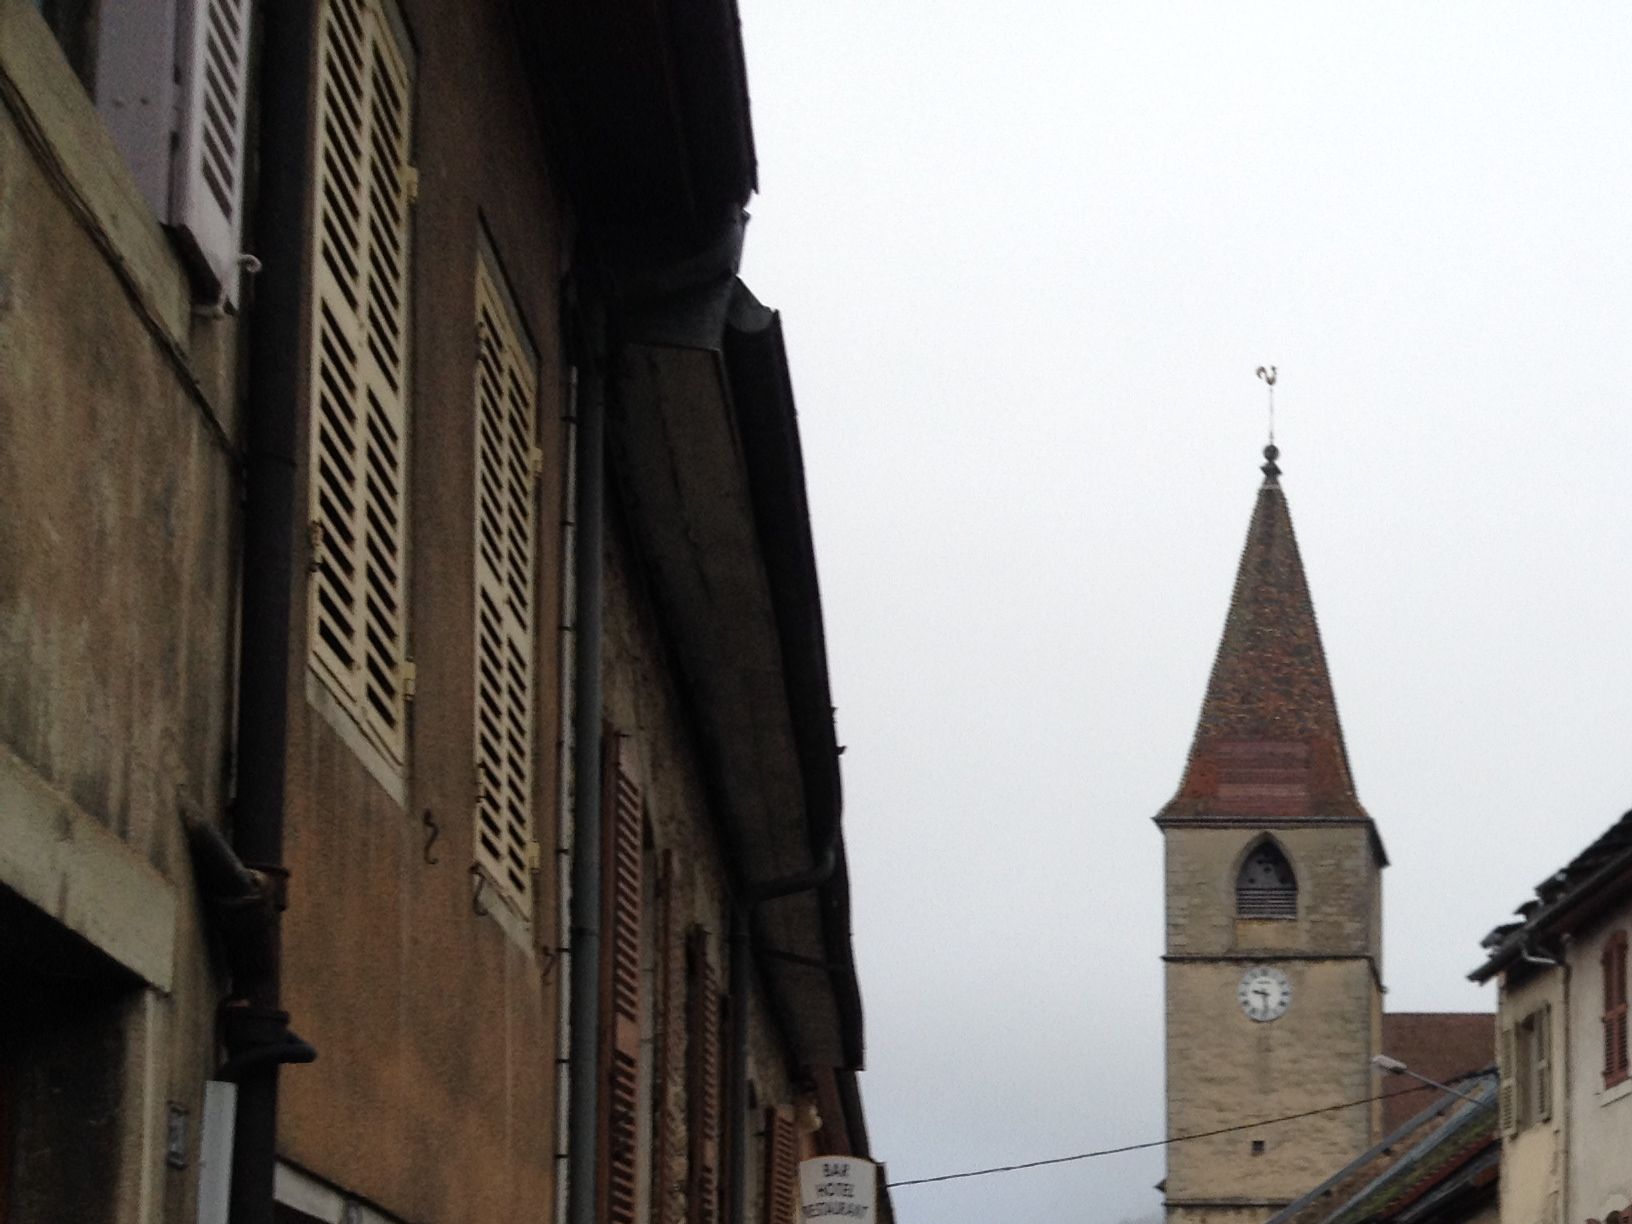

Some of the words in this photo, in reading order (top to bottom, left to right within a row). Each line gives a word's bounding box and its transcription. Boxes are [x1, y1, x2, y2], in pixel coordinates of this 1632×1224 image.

[823, 1163, 849, 1177] BAR
[815, 1182, 855, 1198] HOTEL
[802, 1201, 869, 1219] RESTAURANT
